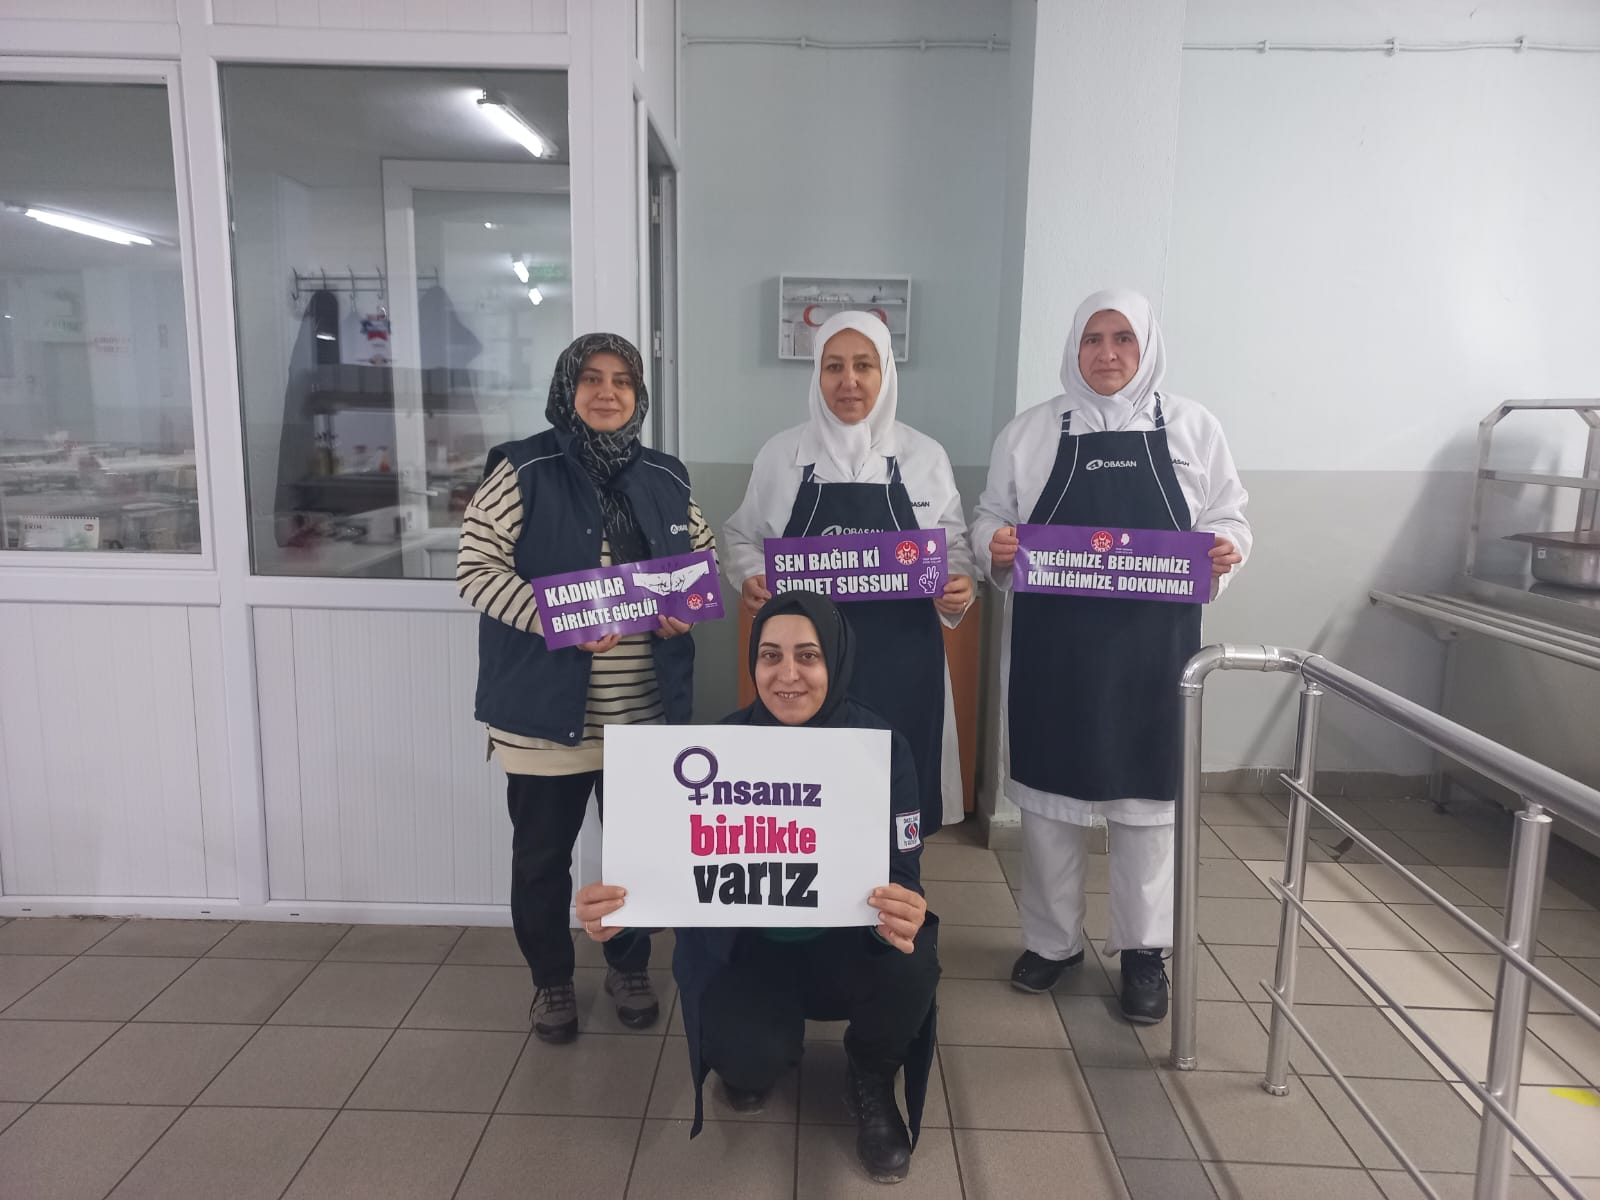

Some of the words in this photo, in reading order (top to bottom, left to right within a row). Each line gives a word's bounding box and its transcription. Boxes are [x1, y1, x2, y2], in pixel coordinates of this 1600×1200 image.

[1103, 460, 1137, 468] OBASAN
[774, 554, 805, 573] SEN
[808, 548, 859, 572] BAĞIR
[862, 546, 880, 569] Kİ
[1029, 549, 1105, 570] EMEĞİMİZE,
[1107, 555, 1191, 574] BEDENİMİZE
[544, 576, 626, 608] KADINLAR
[836, 573, 909, 595] SUSSUN!
[1027, 569, 1114, 592] KİMLİĞİMİZE,
[1117, 576, 1194, 596] DOKUNMA!
[551, 607, 612, 633] BİRLİKTE
[612, 597, 659, 622] GÜÇLÜ!
[690, 814, 817, 857] birlikte
[693, 861, 819, 908] varız
